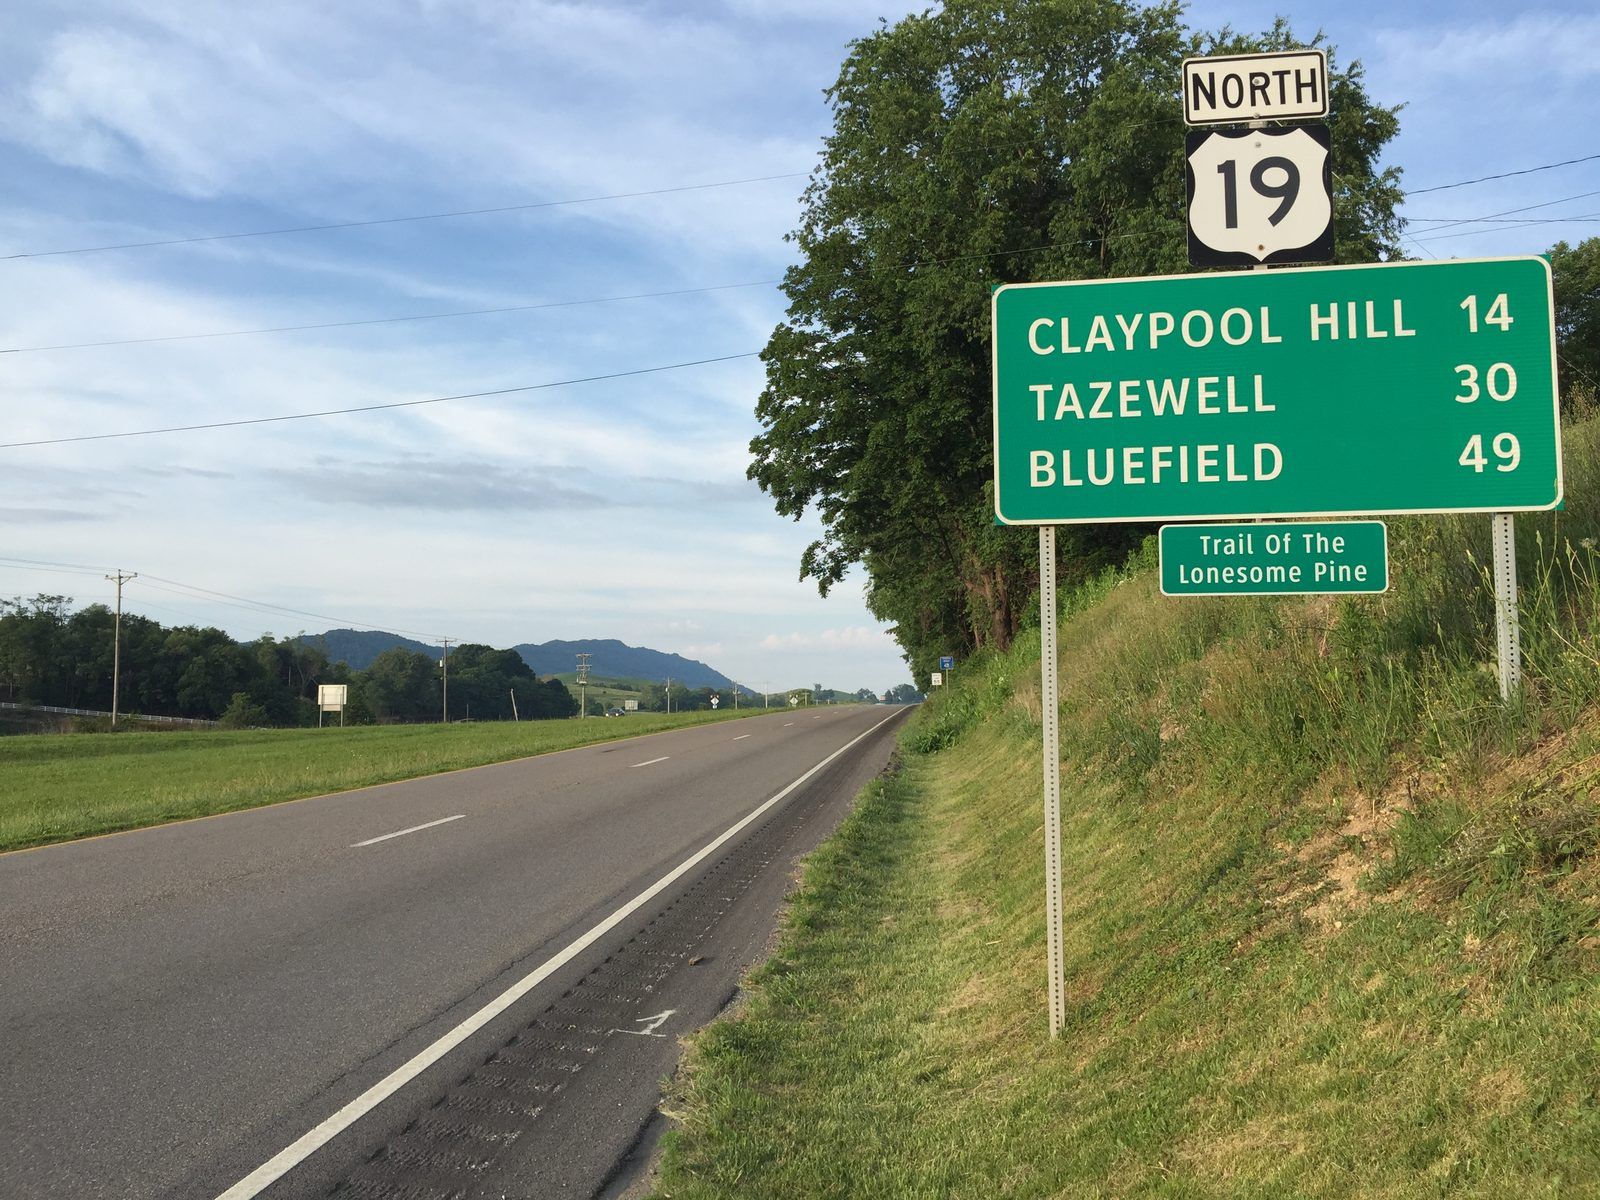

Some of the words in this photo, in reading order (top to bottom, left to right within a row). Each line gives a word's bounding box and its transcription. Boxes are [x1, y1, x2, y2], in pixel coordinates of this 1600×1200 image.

[1192, 68, 1318, 110] NORTH
[1217, 156, 1300, 229] 19
[1029, 306, 1282, 355] CLAYPOOL
[1311, 299, 1416, 341] HILL
[1460, 294, 1514, 333] 14
[1029, 375, 1276, 421] TAZEWELL
[1455, 363, 1518, 403] 30
[1030, 443, 1283, 487] BLUEFIELD
[1459, 433, 1521, 472] 49
[1200, 534, 1254, 555] Trail
[1266, 533, 1291, 554] Of
[1303, 533, 1345, 553] The
[1180, 565, 1302, 584] Lonesome
[1315, 563, 1367, 582] Pine
